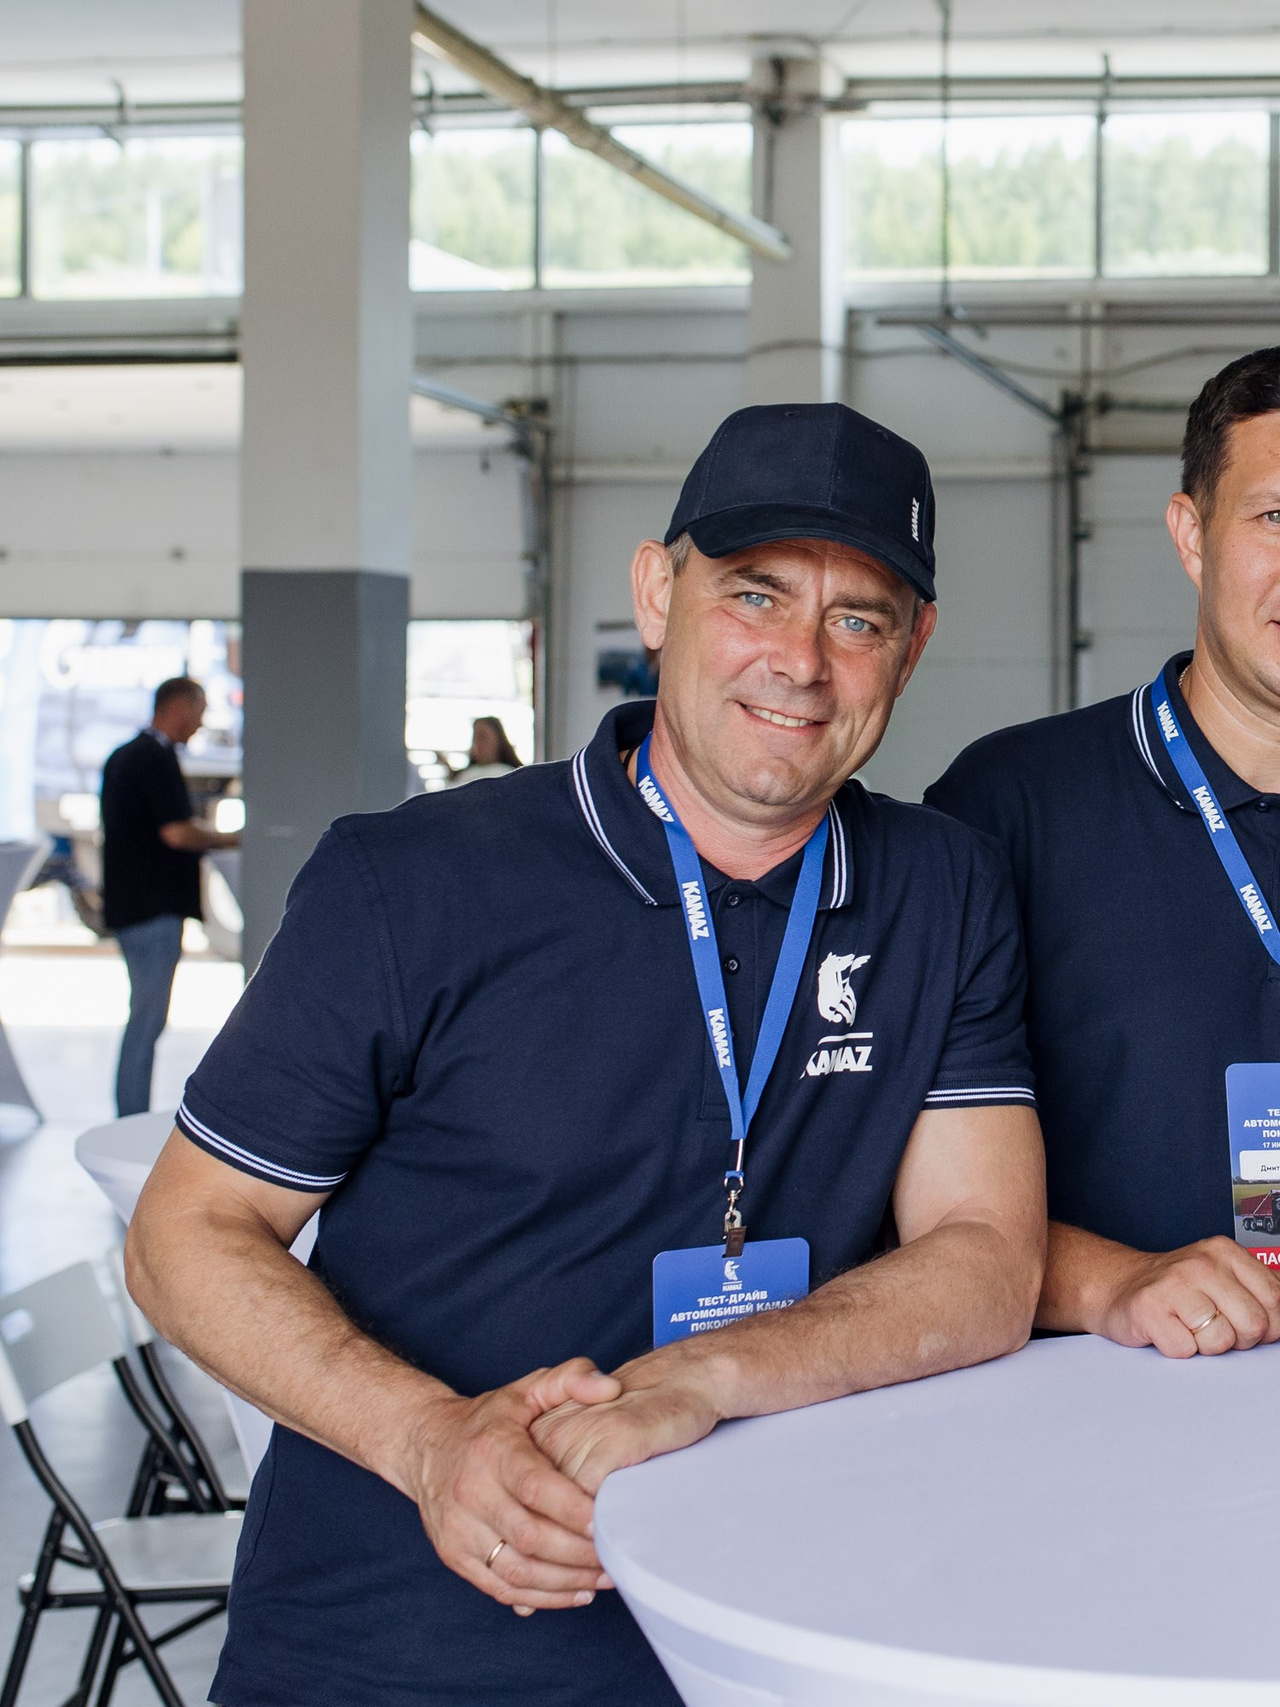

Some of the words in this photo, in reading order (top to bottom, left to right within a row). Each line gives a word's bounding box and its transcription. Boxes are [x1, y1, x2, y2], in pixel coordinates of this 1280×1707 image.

[1157, 701, 1179, 742] KAMAZ
[638, 775, 675, 823] KAMAZ
[1193, 785, 1226, 833] KAMAZ
[682, 880, 710, 941] KAMAZ
[1240, 883, 1273, 934] KAMAZ
[708, 1008, 731, 1069] KAMAZ
[670, 1303, 754, 1323] АВТОМОБИЛЕЙ
[697, 1290, 768, 1307] ТЕСТ-ДРАЙВ
